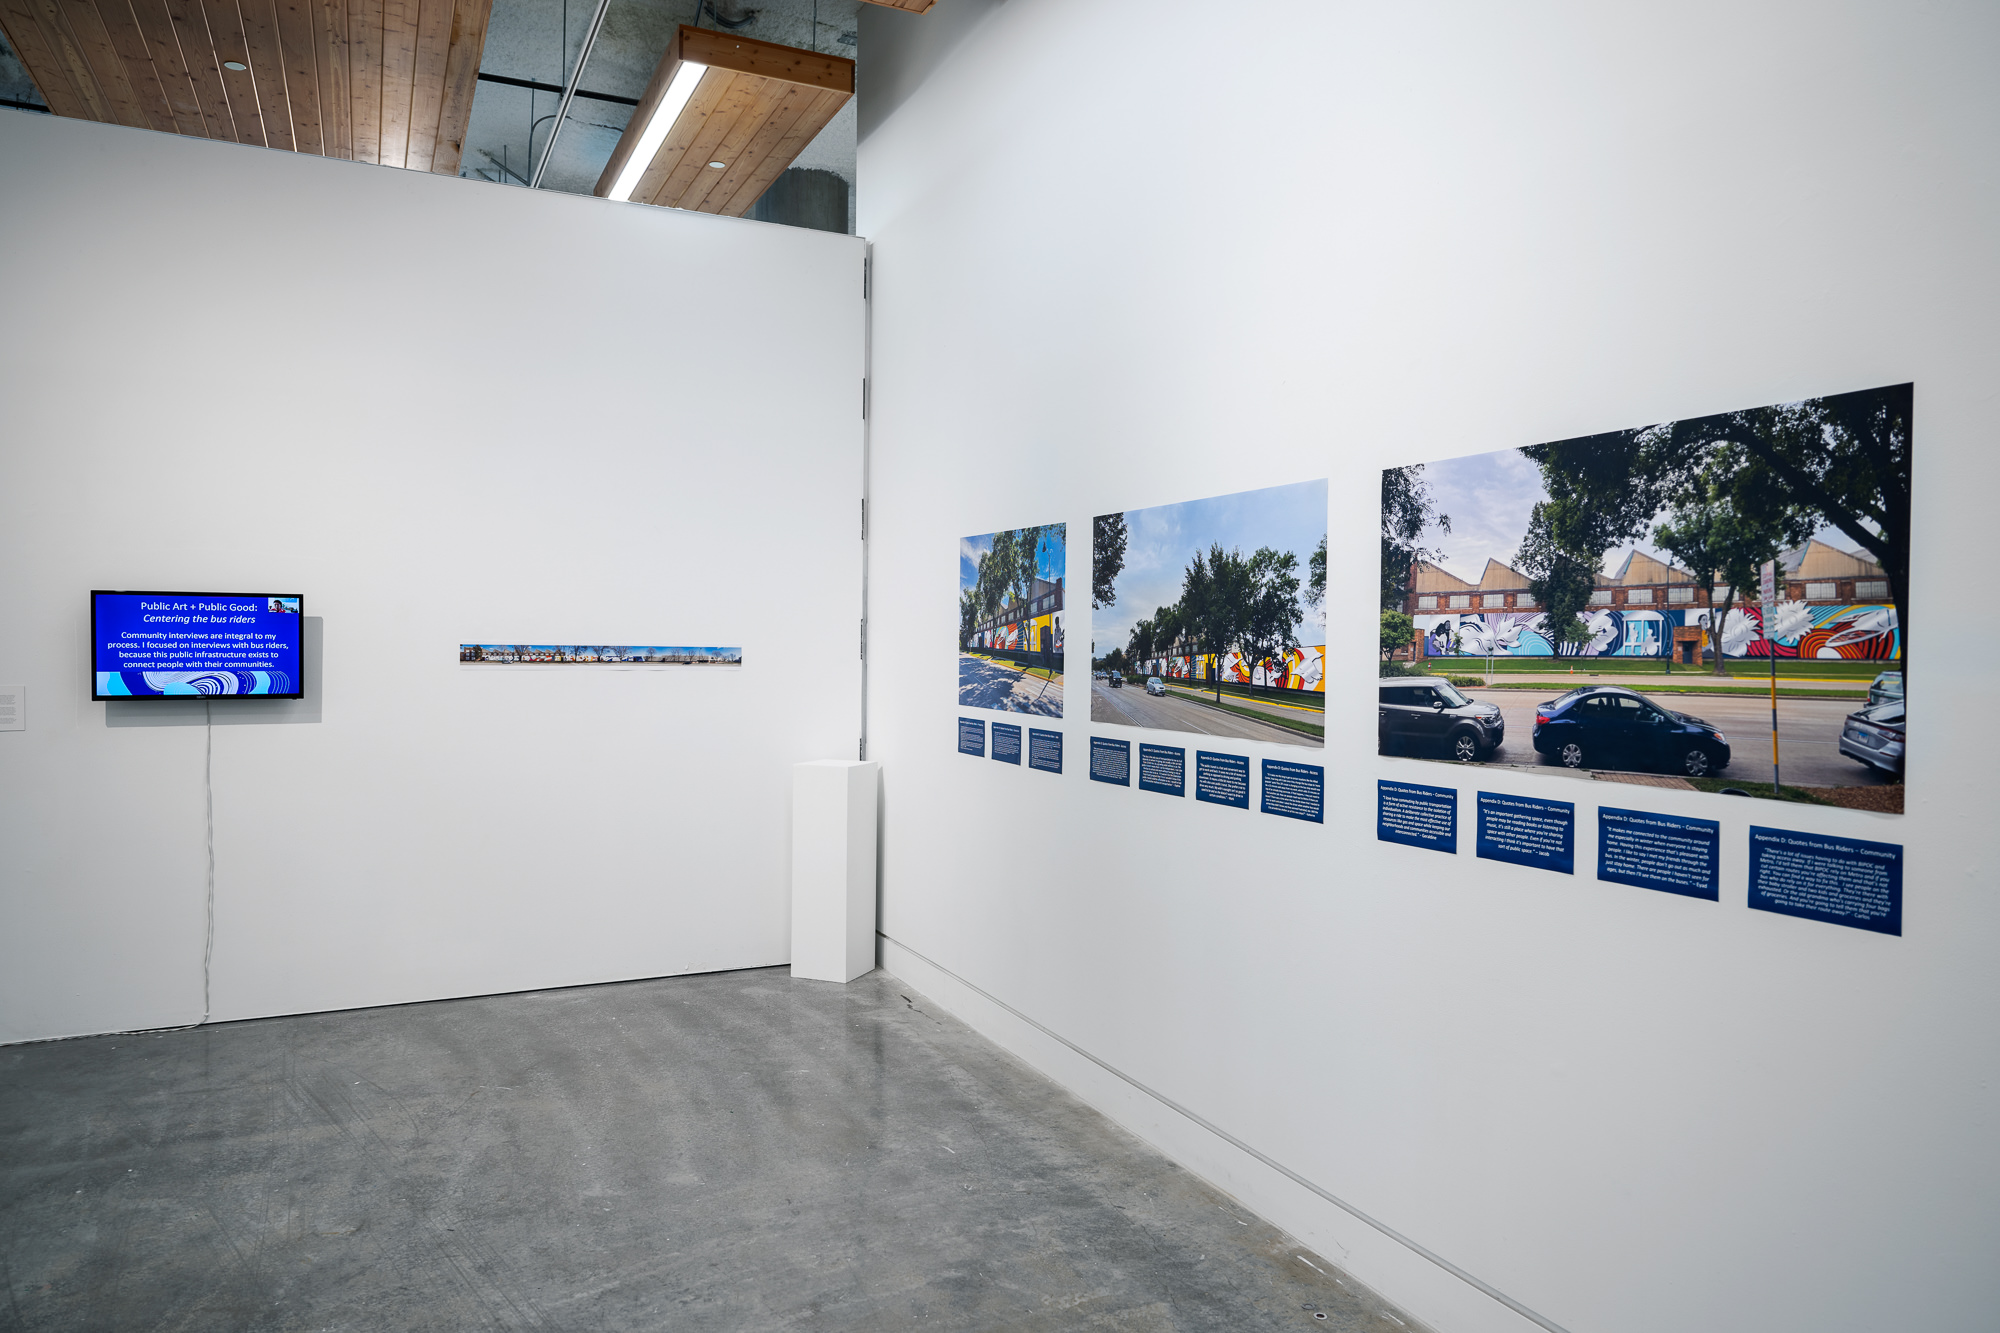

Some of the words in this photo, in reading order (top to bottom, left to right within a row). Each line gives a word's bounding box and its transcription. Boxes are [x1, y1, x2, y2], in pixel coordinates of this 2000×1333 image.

[141, 602, 170, 610] Public
[199, 603, 227, 611] Public
[144, 614, 190, 624] Centering
[193, 615, 208, 623] the
[210, 615, 227, 623] bus
[229, 615, 255, 623] riders
[121, 632, 167, 640] Community
[170, 651, 193, 659] public
[1686, 825, 1713, 833] Community
[1755, 834, 1779, 842] Appendix
[1860, 849, 1895, 859] Community
